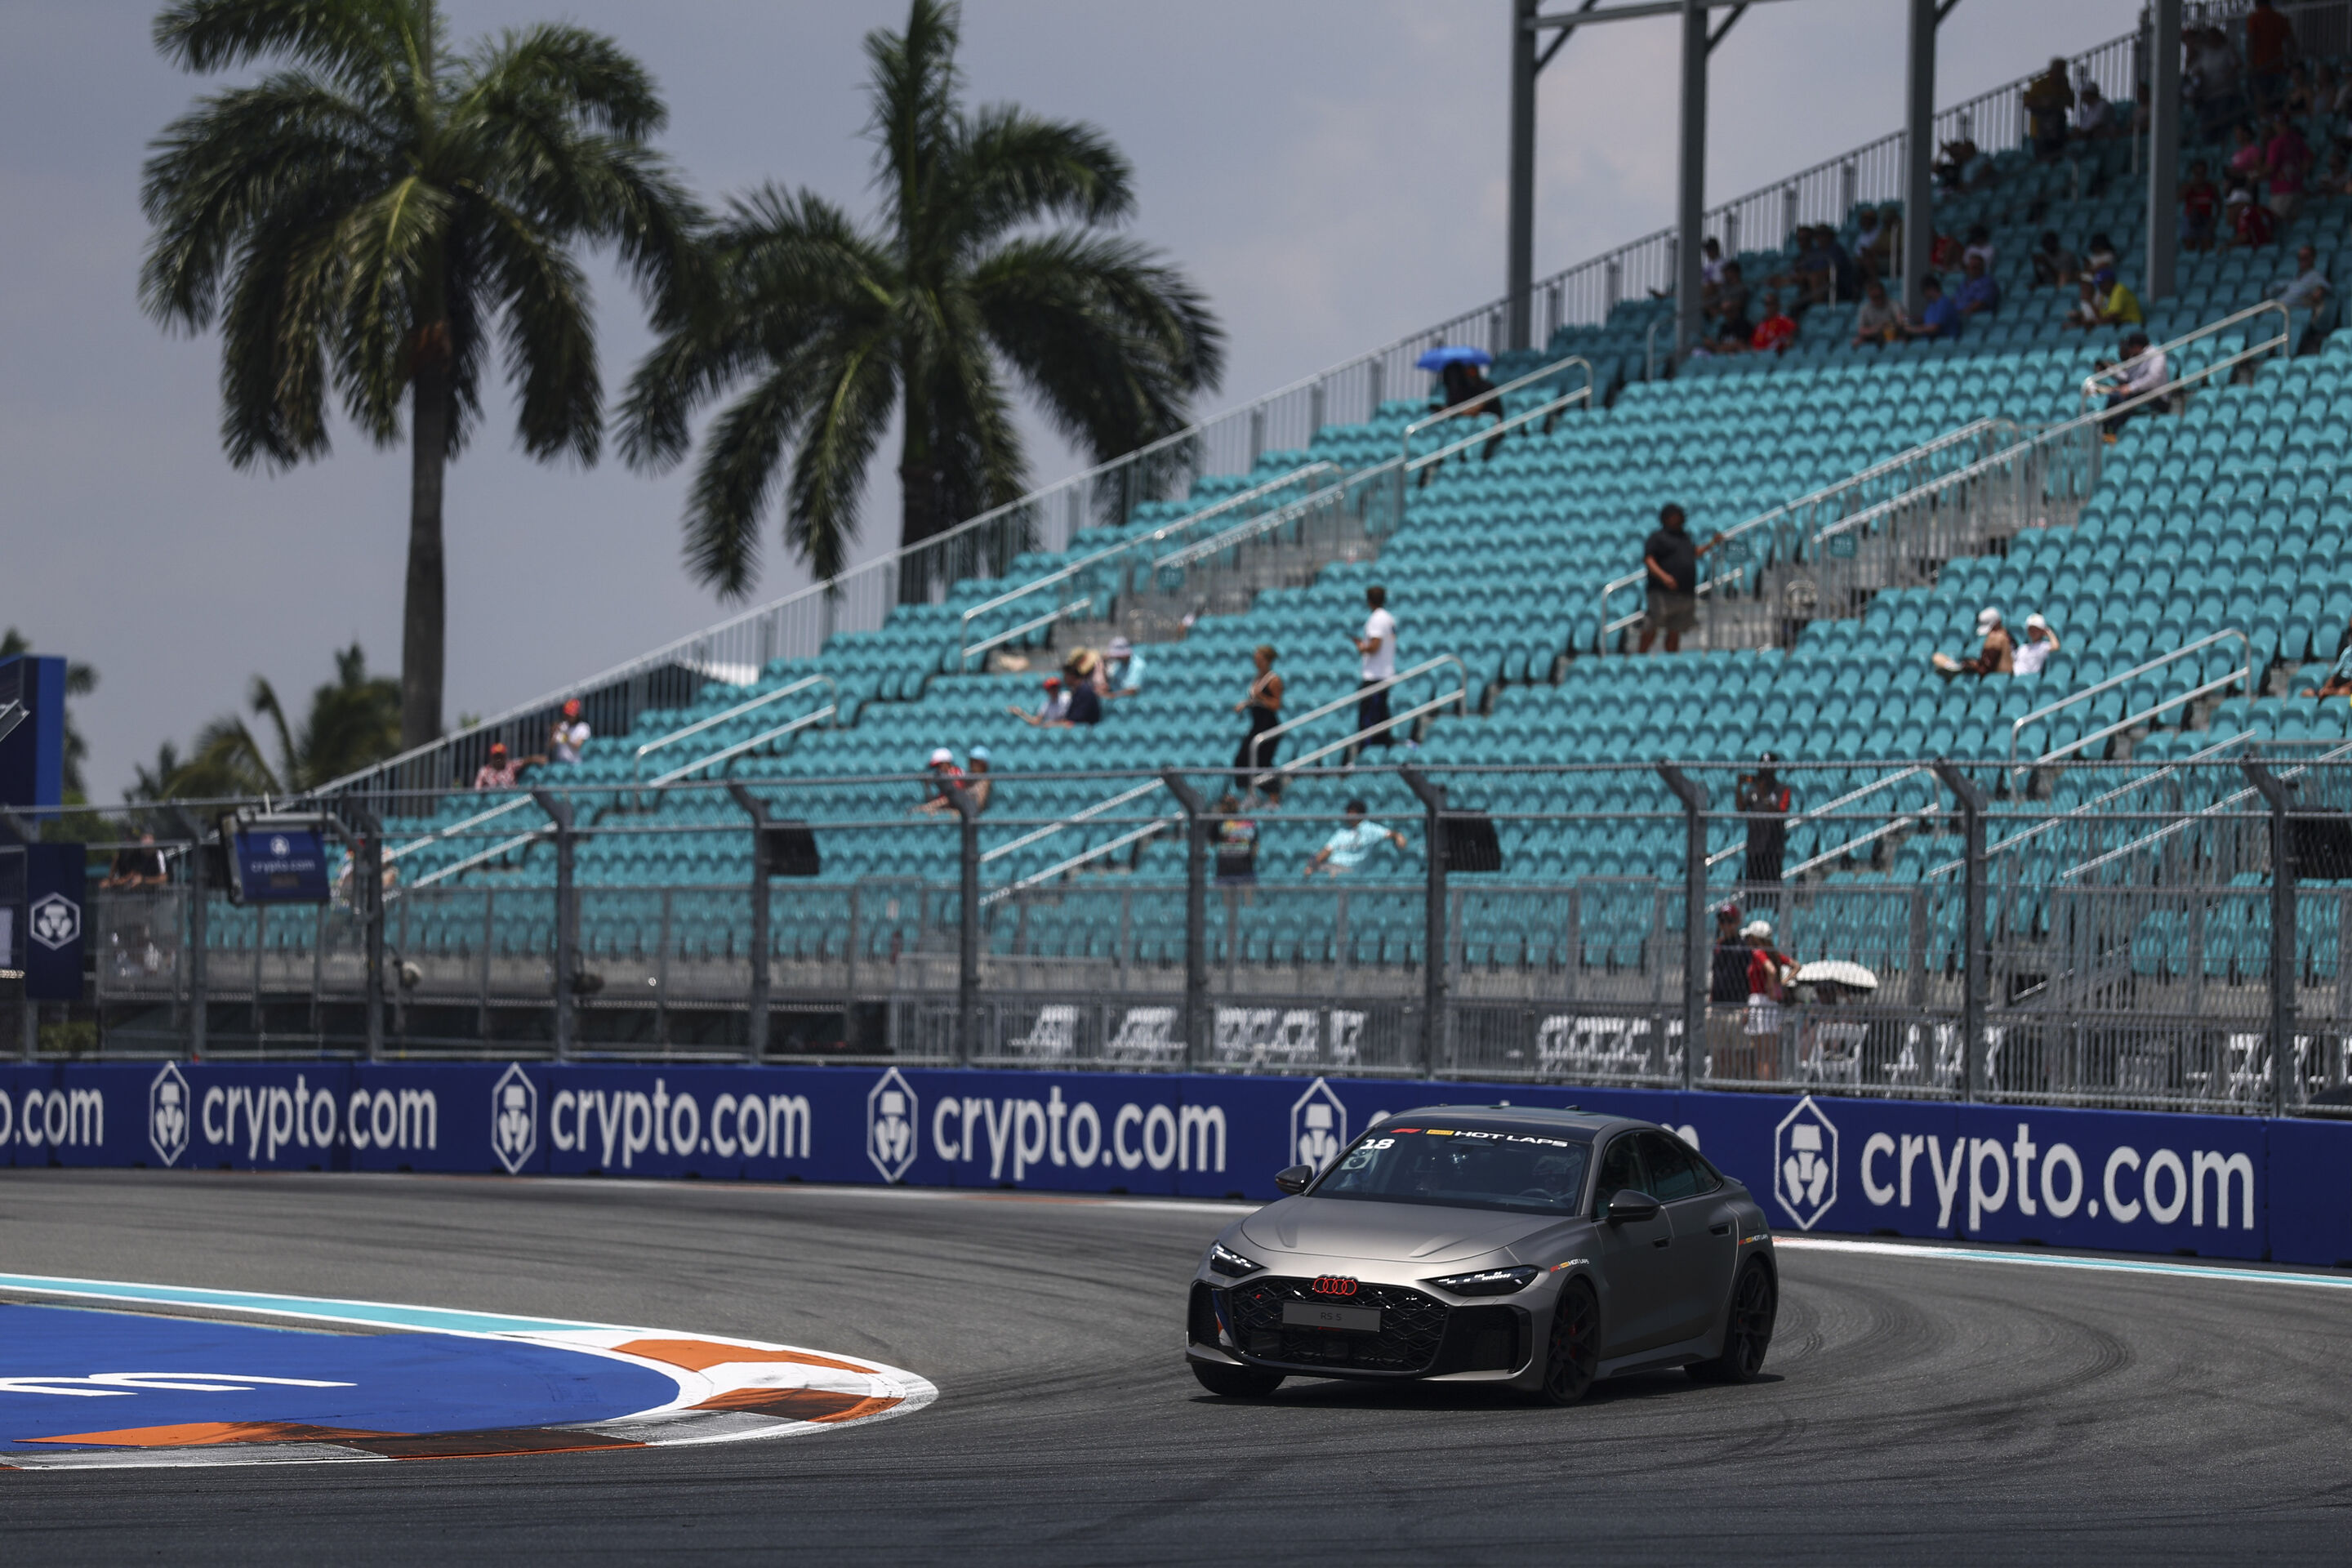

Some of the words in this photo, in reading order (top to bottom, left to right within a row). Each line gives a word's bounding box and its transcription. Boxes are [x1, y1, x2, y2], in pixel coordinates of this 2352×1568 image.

[203, 1075, 437, 1160] crypto.com
[550, 1077, 811, 1168] crypto.com
[933, 1085, 1227, 1181] crypto.com
[1360, 1138, 1396, 1150] 18
[1454, 1130, 1504, 1139] HOT
[1506, 1135, 1568, 1147] LAPS
[1860, 1123, 2254, 1232] crypto.com
[1320, 1312, 1333, 1321] RS
